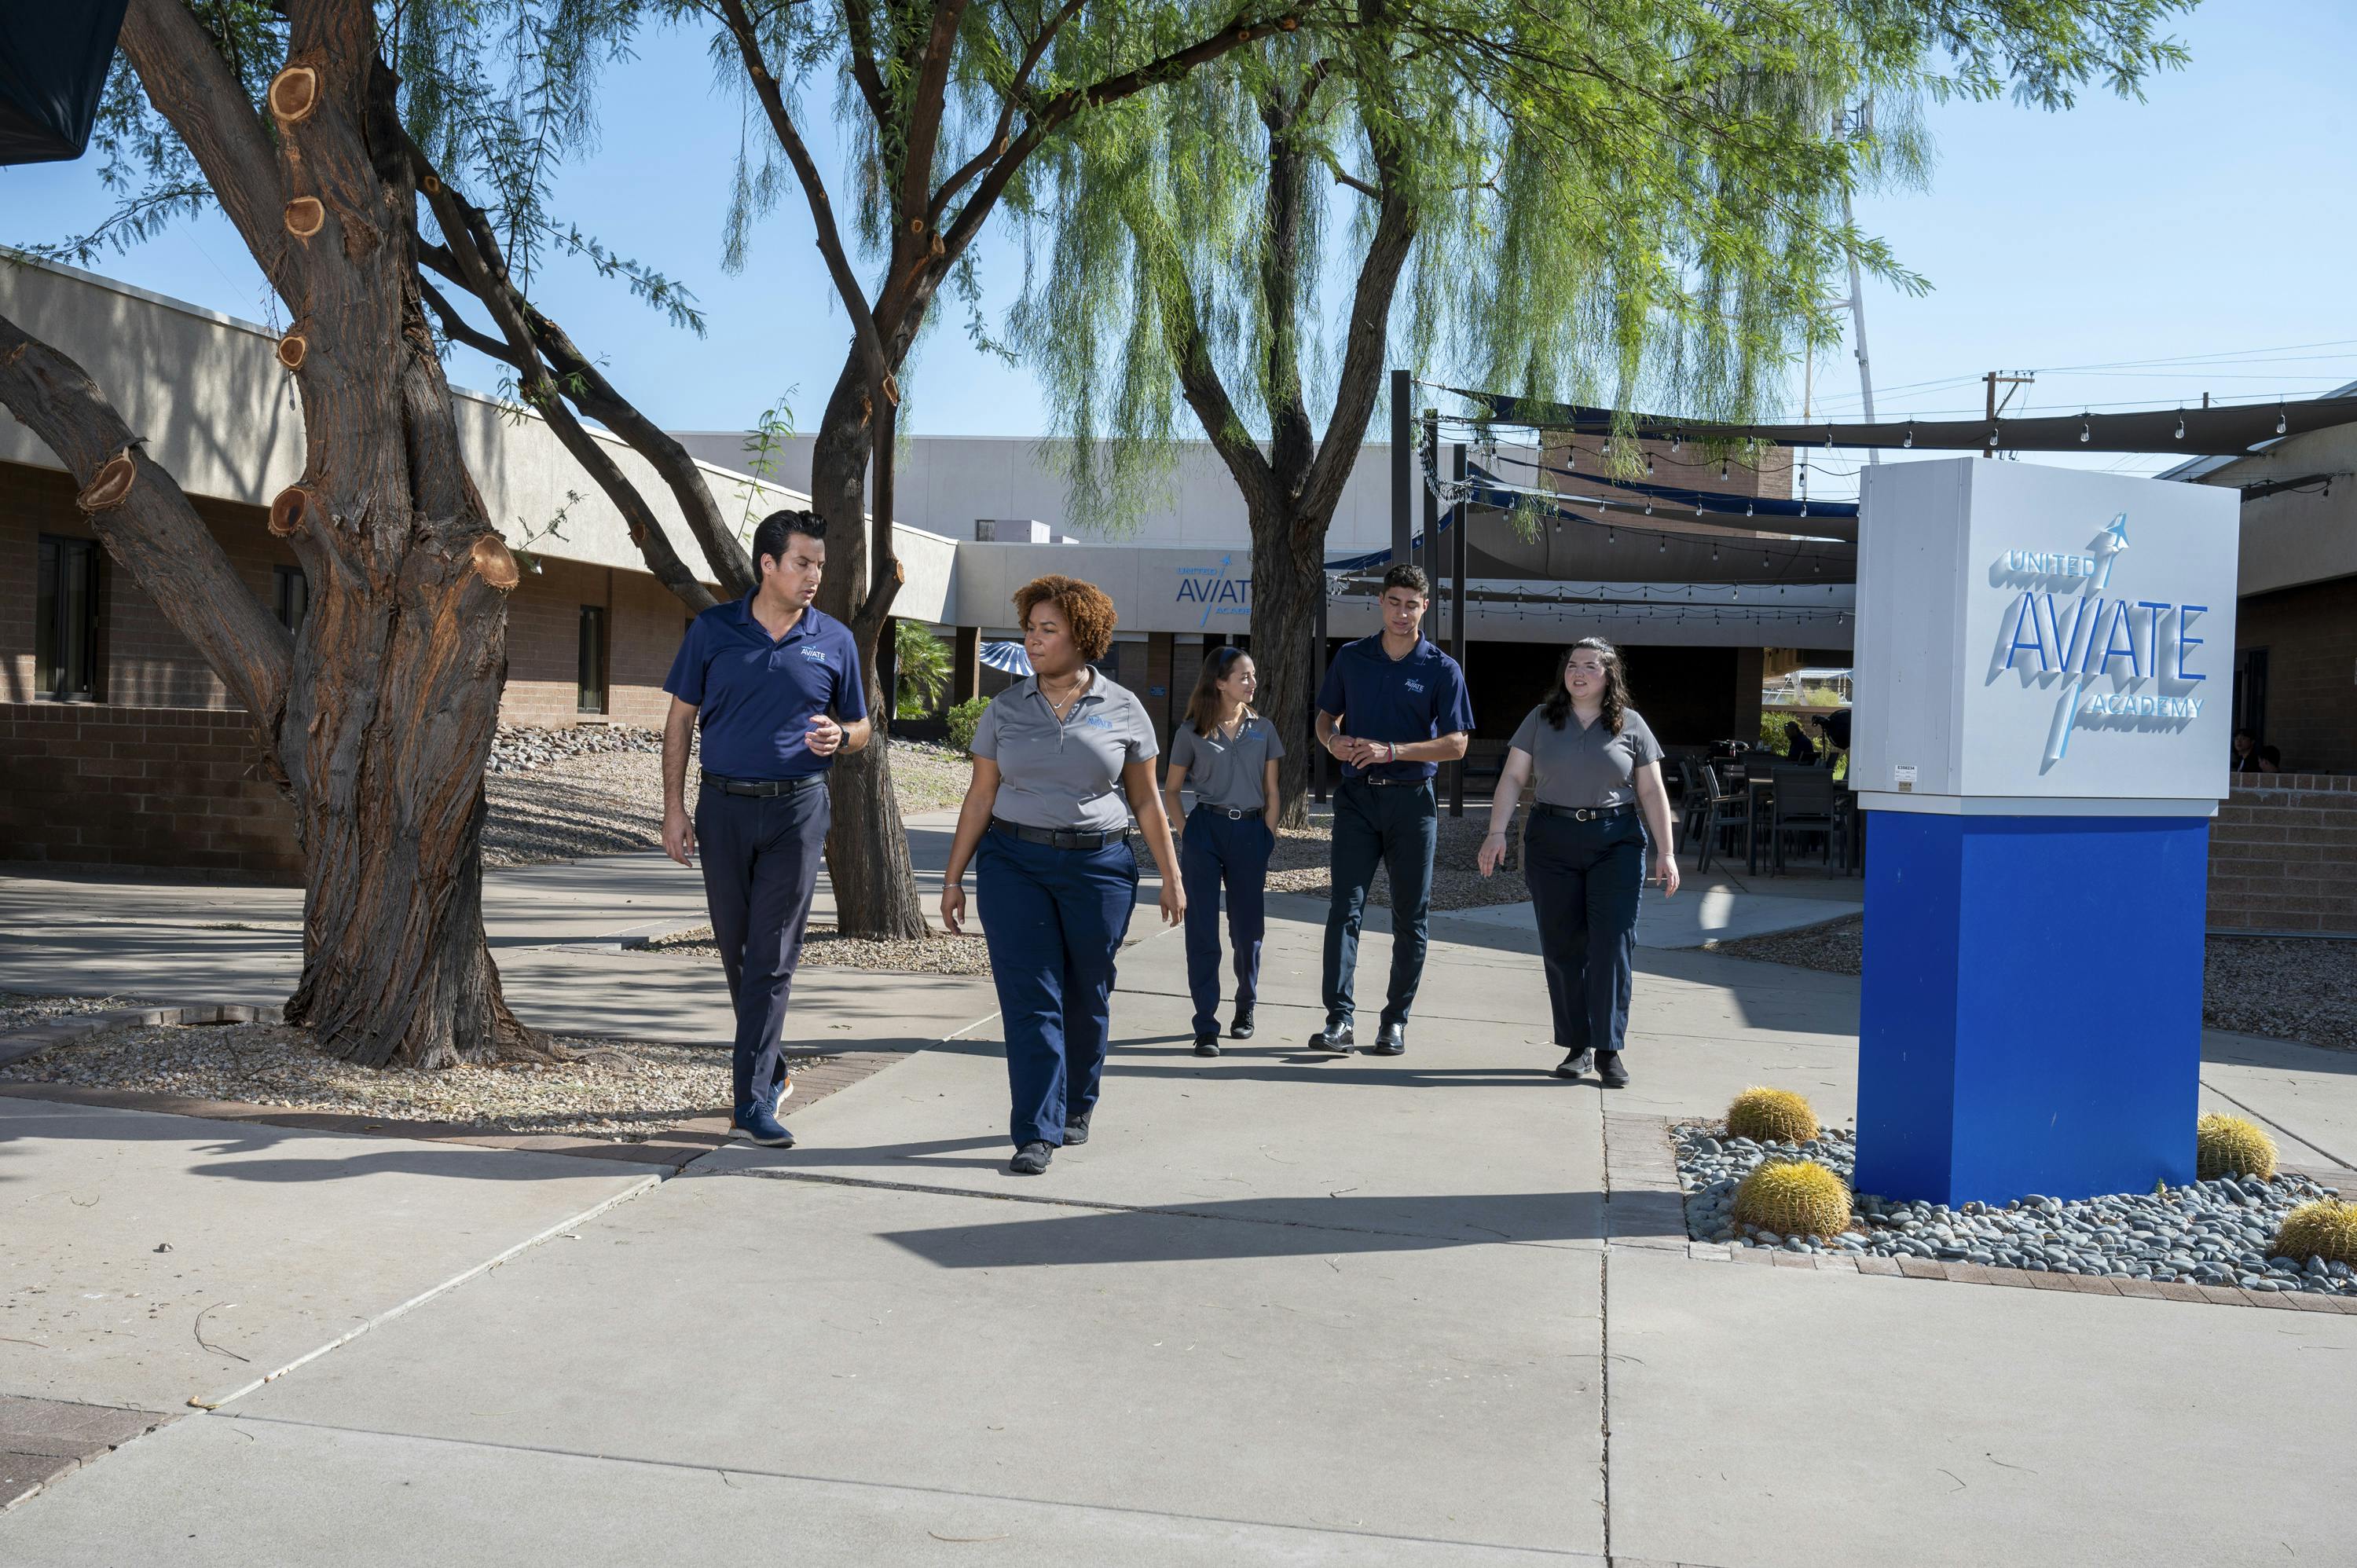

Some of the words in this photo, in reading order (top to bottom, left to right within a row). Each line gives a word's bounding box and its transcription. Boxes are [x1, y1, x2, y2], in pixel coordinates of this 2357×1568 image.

[2011, 549, 2097, 577] UNITED
[1176, 578, 1252, 603] AVIAT
[2007, 591, 2209, 680] AVIATE
[801, 648, 826, 660] AVIATE
[1404, 680, 1425, 691] AVIATE
[2091, 694, 2205, 717] ACADEMY
